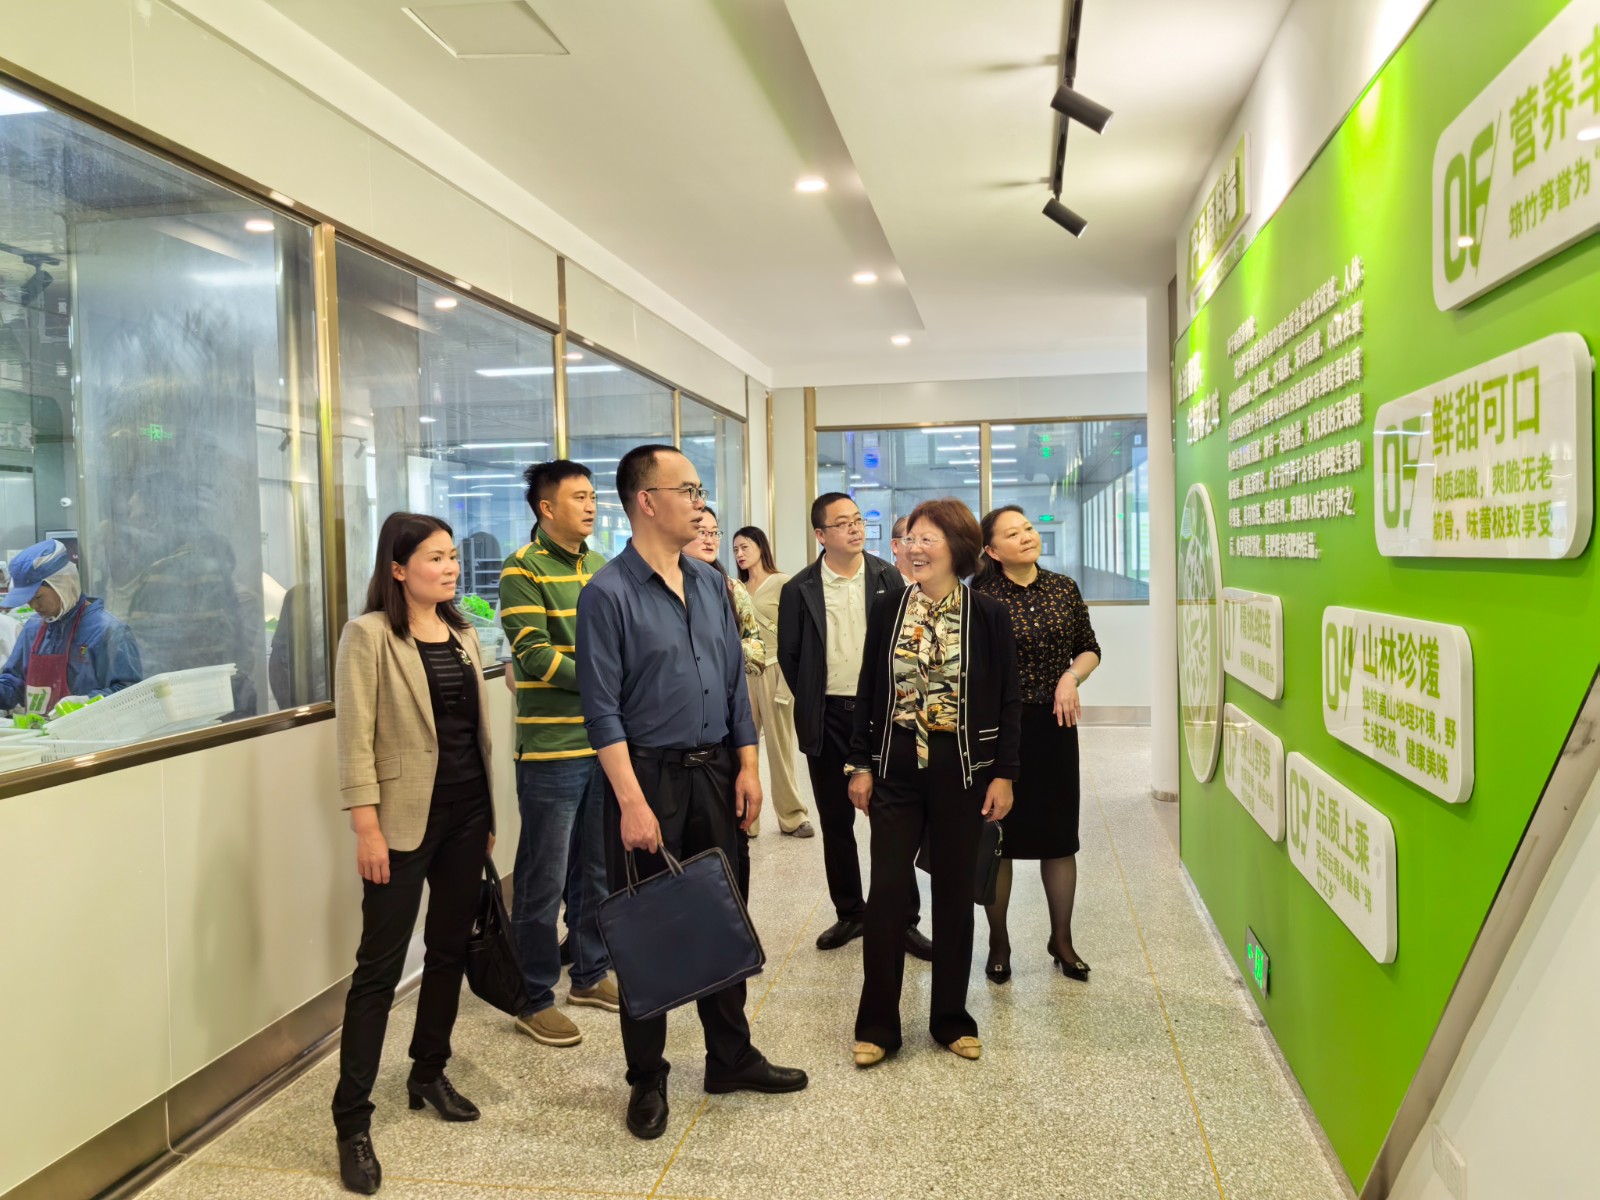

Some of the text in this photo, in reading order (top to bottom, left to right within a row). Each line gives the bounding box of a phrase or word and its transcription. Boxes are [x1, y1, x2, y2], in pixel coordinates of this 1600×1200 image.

[1432, 366, 1540, 457] 鲜甜可口
[1432, 452, 1553, 502] 肉质细嫩，爽脆无老
[1432, 500, 1553, 542] 筋骨，味蕾极致享受
[1363, 624, 1441, 700] 山林珍馐
[1362, 685, 1456, 750] 独特高山地理环境，野
[1363, 716, 1448, 784] 生纯天然、健康美味
[1316, 787, 1370, 876] 品质上乘
